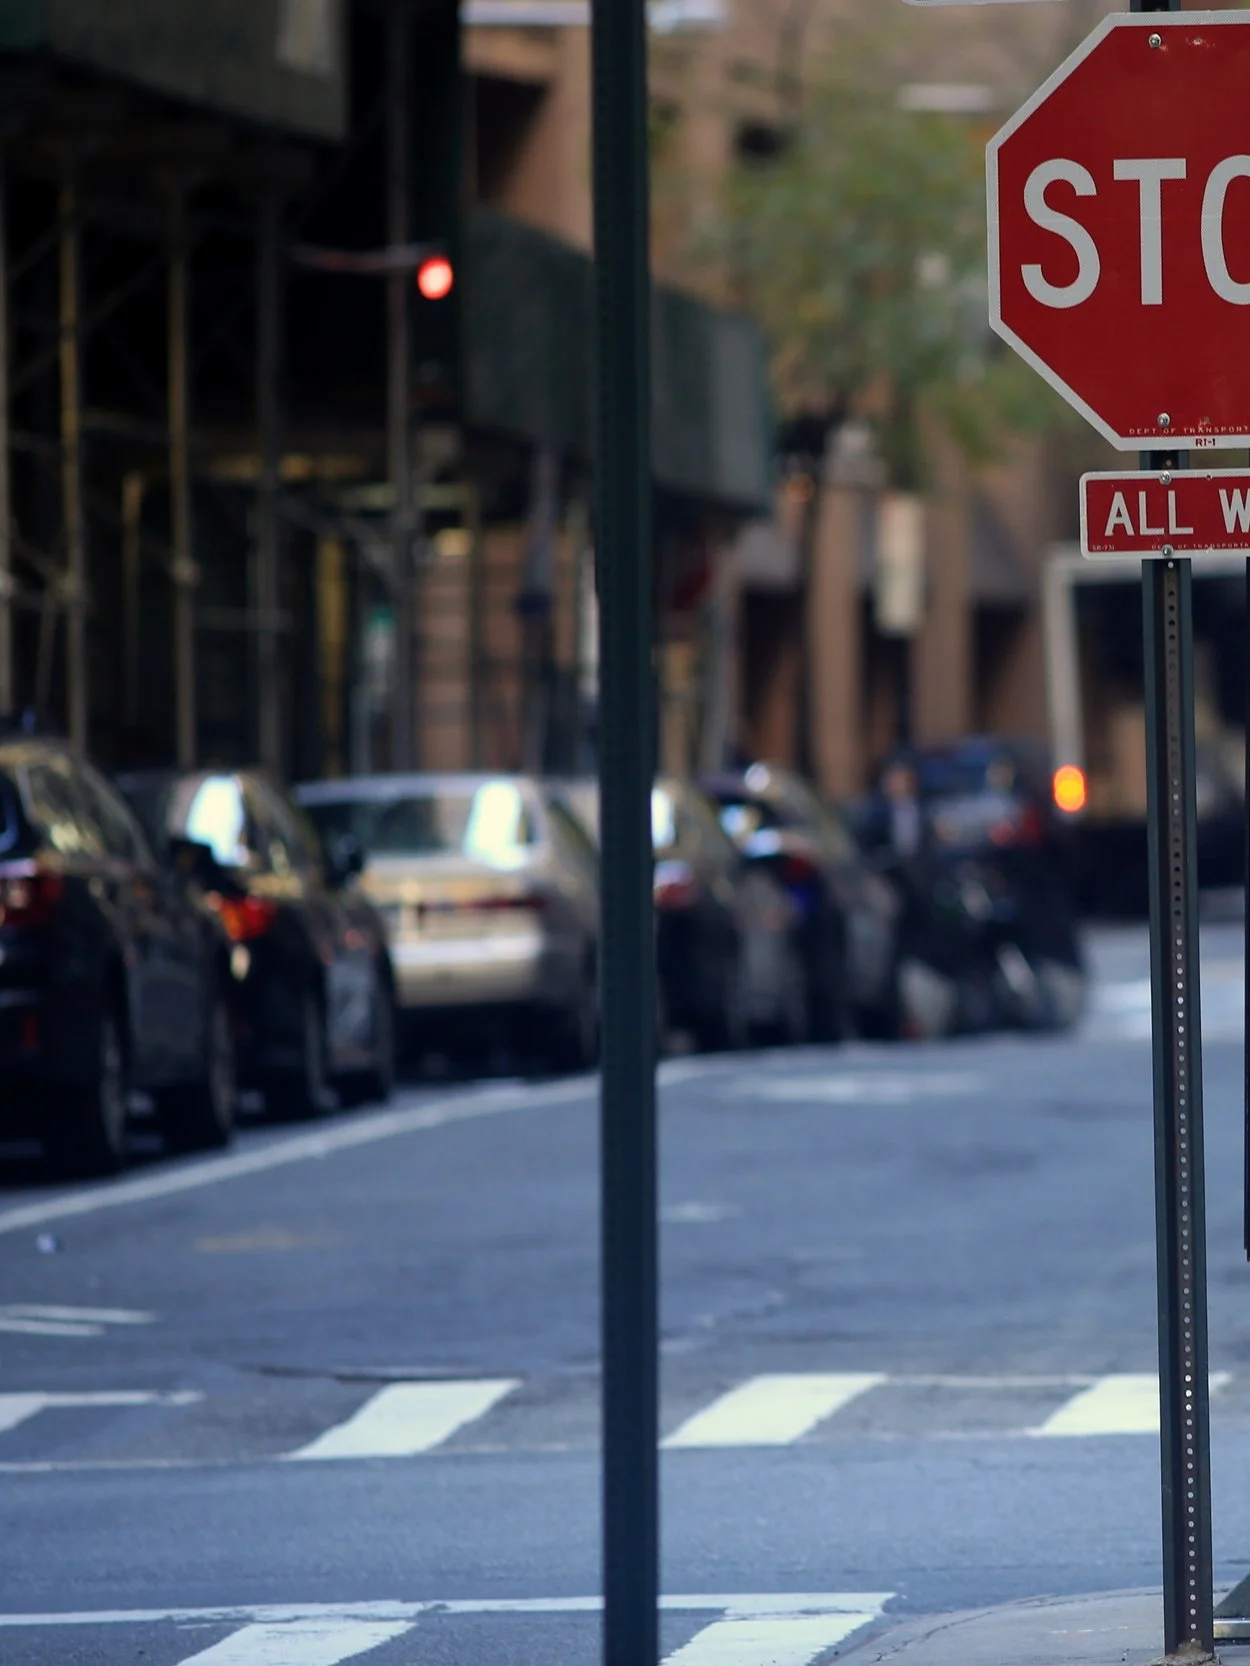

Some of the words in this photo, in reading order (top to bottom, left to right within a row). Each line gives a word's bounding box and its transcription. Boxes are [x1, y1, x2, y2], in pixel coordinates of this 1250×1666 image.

[1163, 426, 1176, 434] OF
[1195, 438, 1216, 447] R1-1
[1104, 490, 1194, 537] ALL
